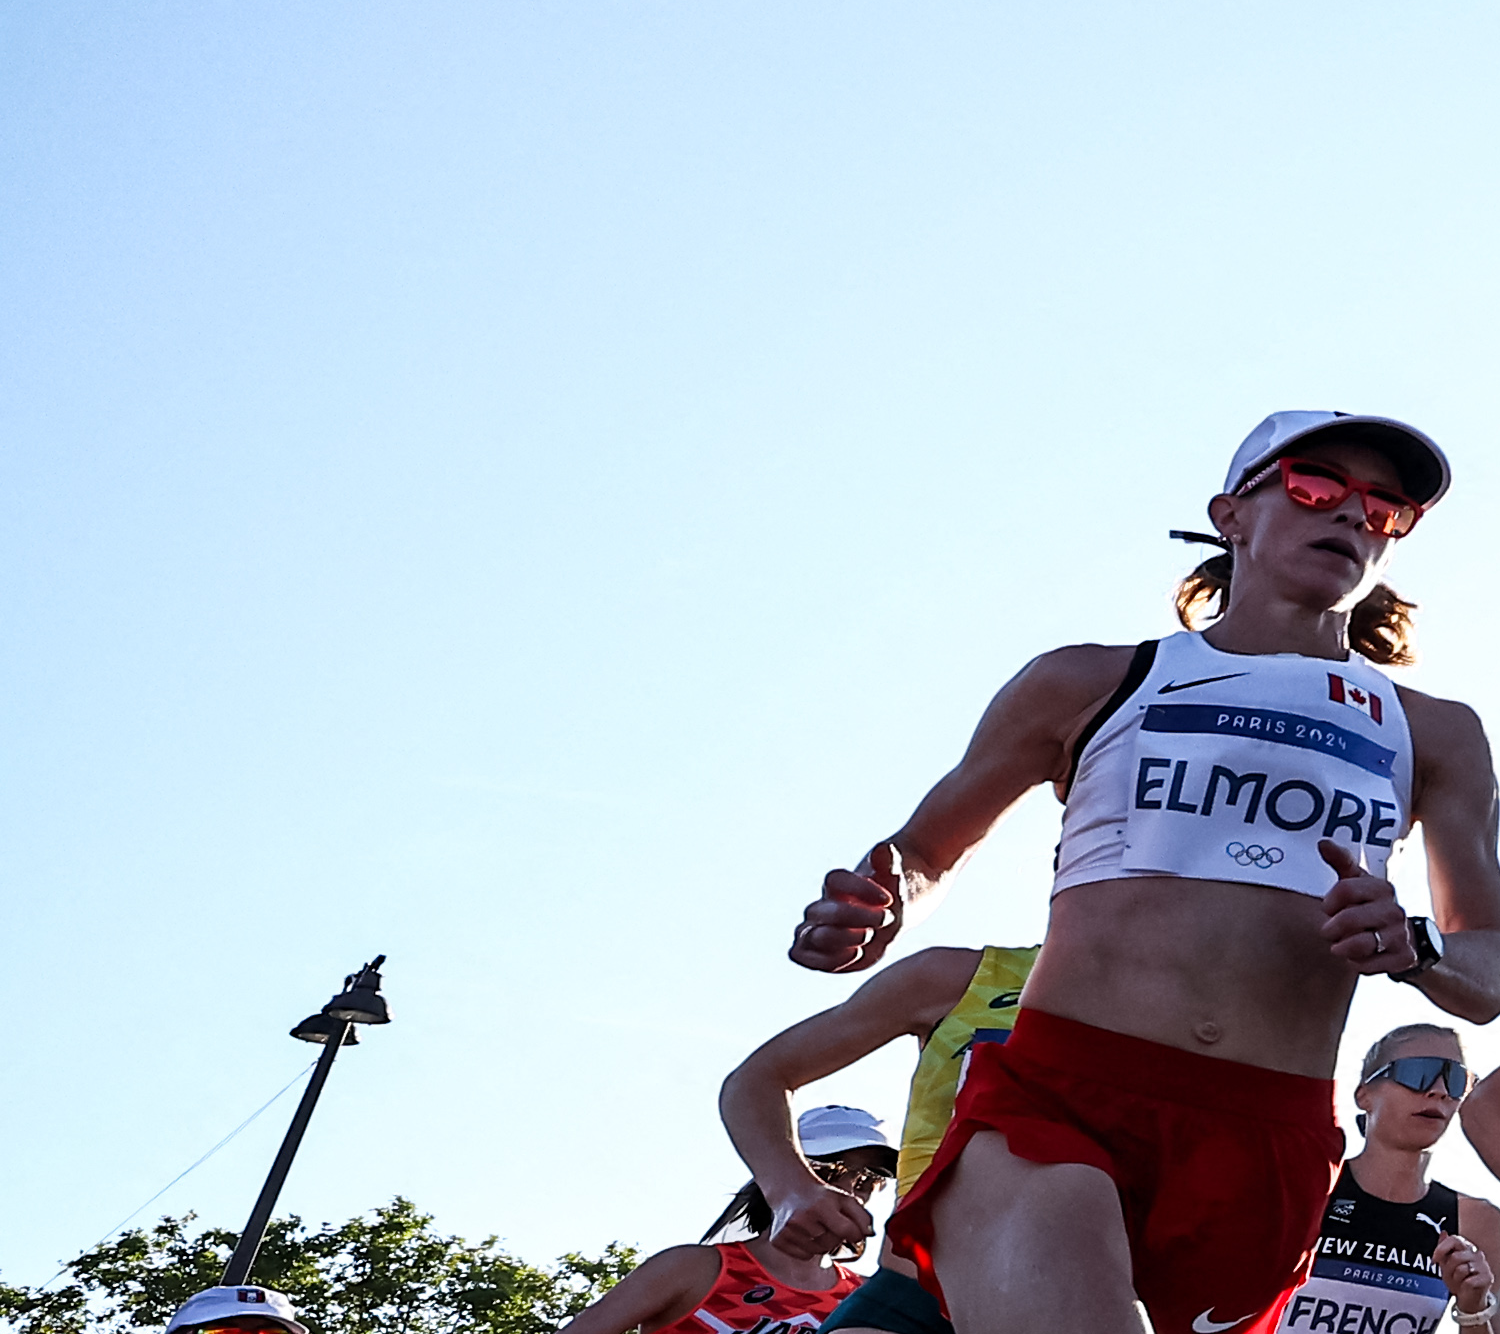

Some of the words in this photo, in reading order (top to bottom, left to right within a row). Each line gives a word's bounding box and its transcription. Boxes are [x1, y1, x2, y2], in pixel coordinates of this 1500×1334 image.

[1217, 713, 1286, 735] PARIS
[1296, 724, 1347, 751] 2024
[1135, 757, 1396, 848] ELMORE
[1343, 1267, 1383, 1282] PARIS
[1387, 1276, 1420, 1289] 2024
[1363, 1242, 1443, 1278] ZEALAN
